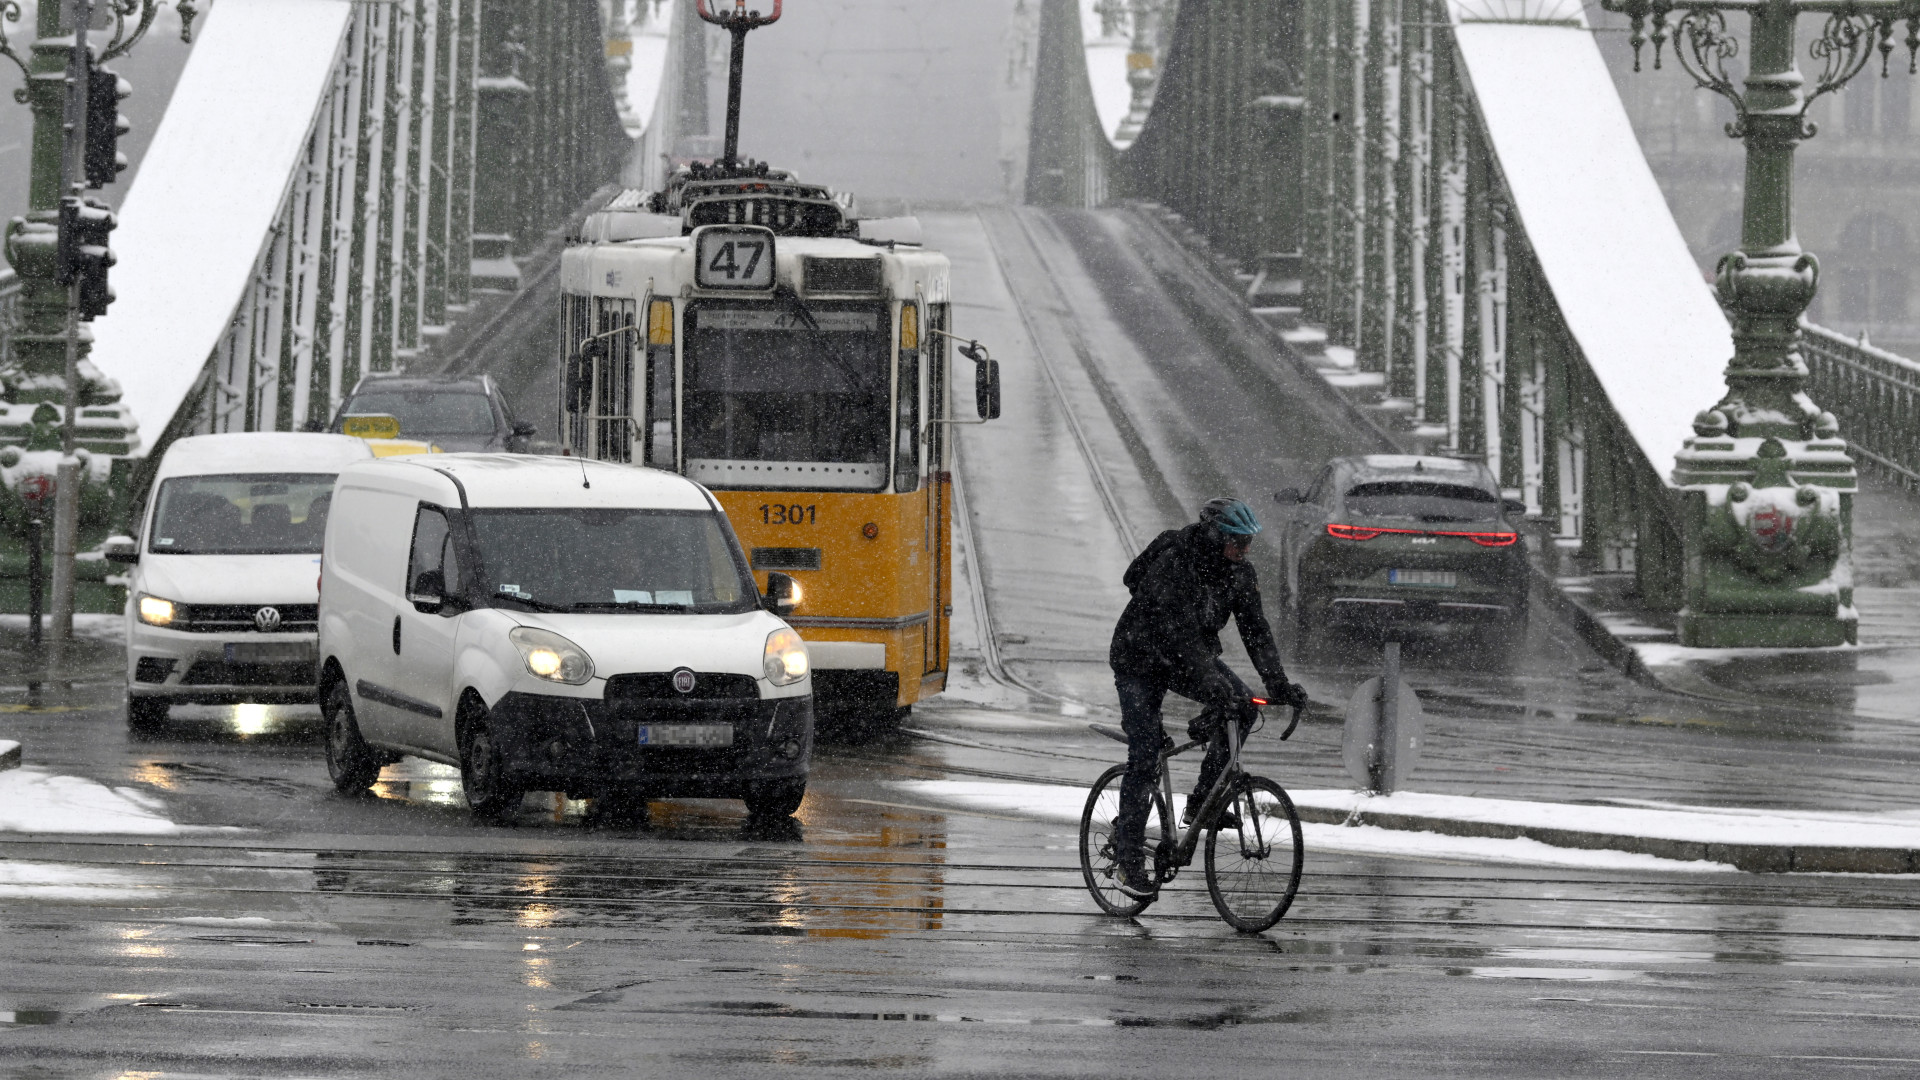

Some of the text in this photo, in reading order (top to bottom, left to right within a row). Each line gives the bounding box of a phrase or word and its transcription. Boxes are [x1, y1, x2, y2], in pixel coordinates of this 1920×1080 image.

[710, 241, 764, 279] 47
[759, 504, 816, 525] 1301
[678, 676, 691, 688] FIAT
